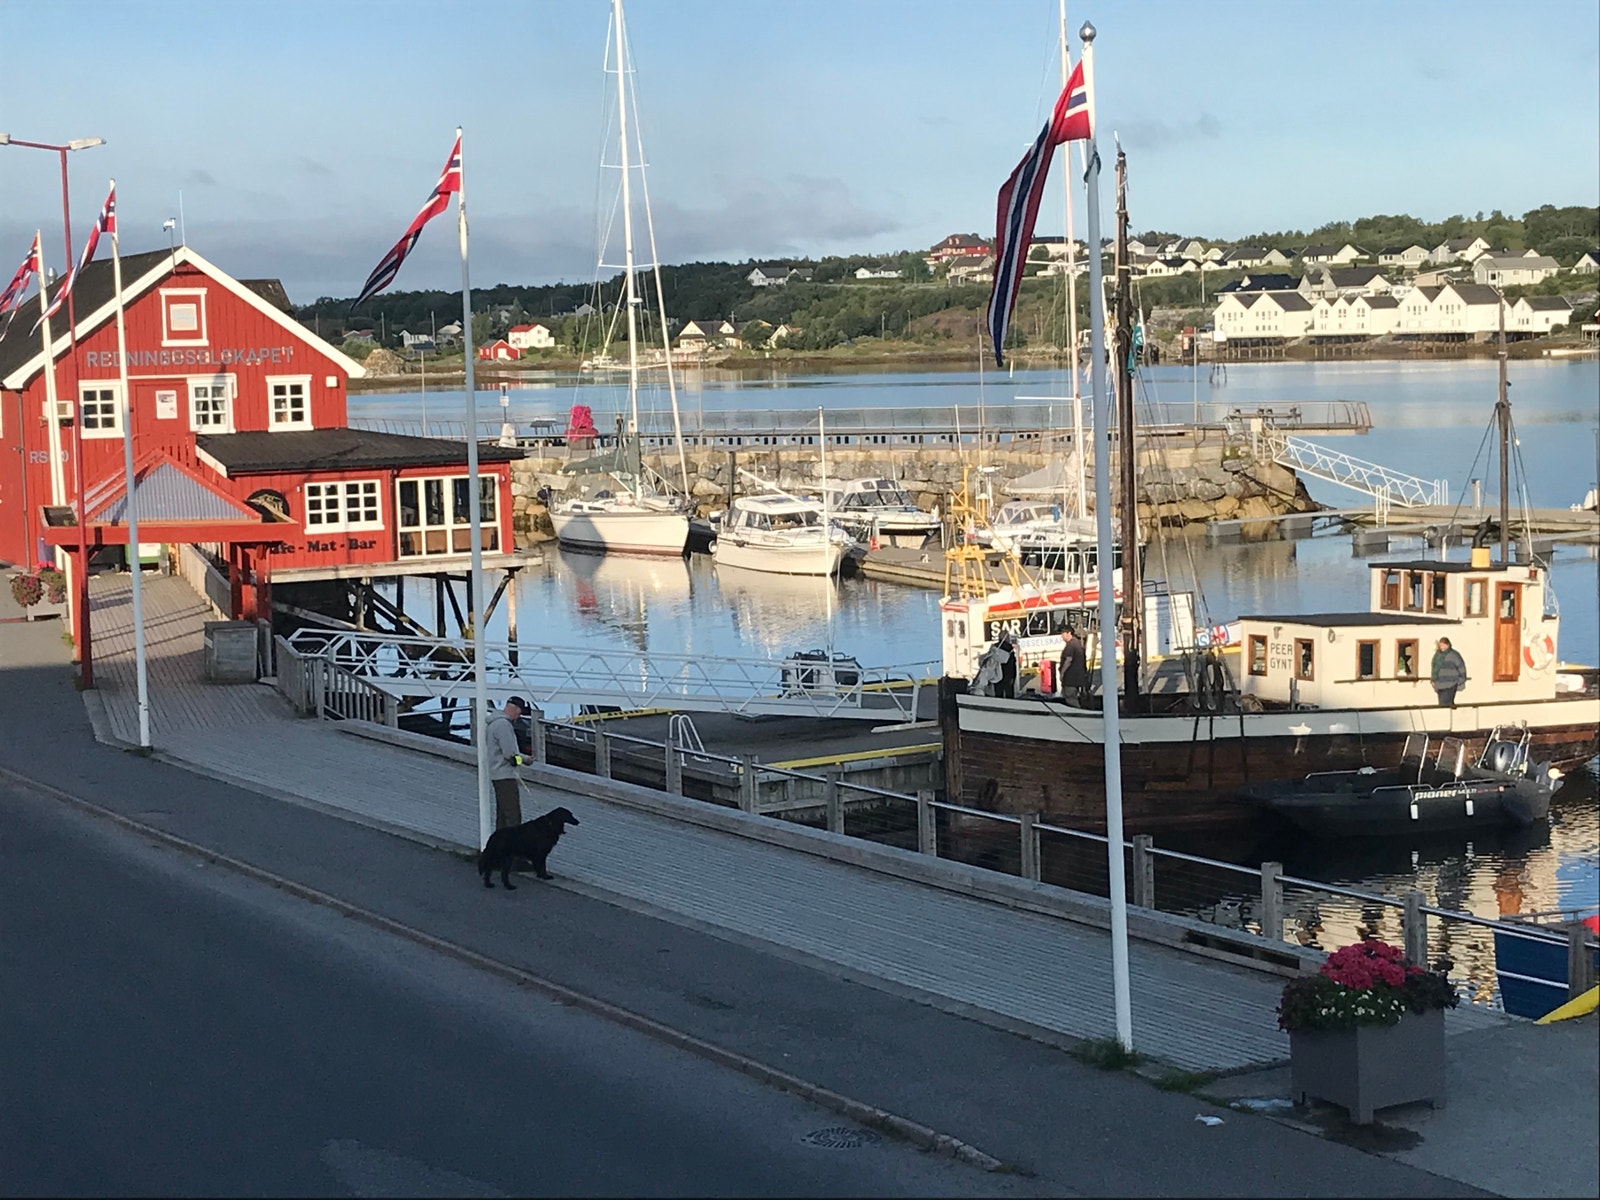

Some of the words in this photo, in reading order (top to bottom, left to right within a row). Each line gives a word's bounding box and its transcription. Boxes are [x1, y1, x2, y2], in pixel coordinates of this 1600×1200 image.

[307, 539, 337, 553] Mat
[348, 538, 377, 550] Bar
[990, 619, 1022, 638] SAR
[1270, 642, 1293, 656] PEER
[1270, 657, 1293, 670] GYNT
